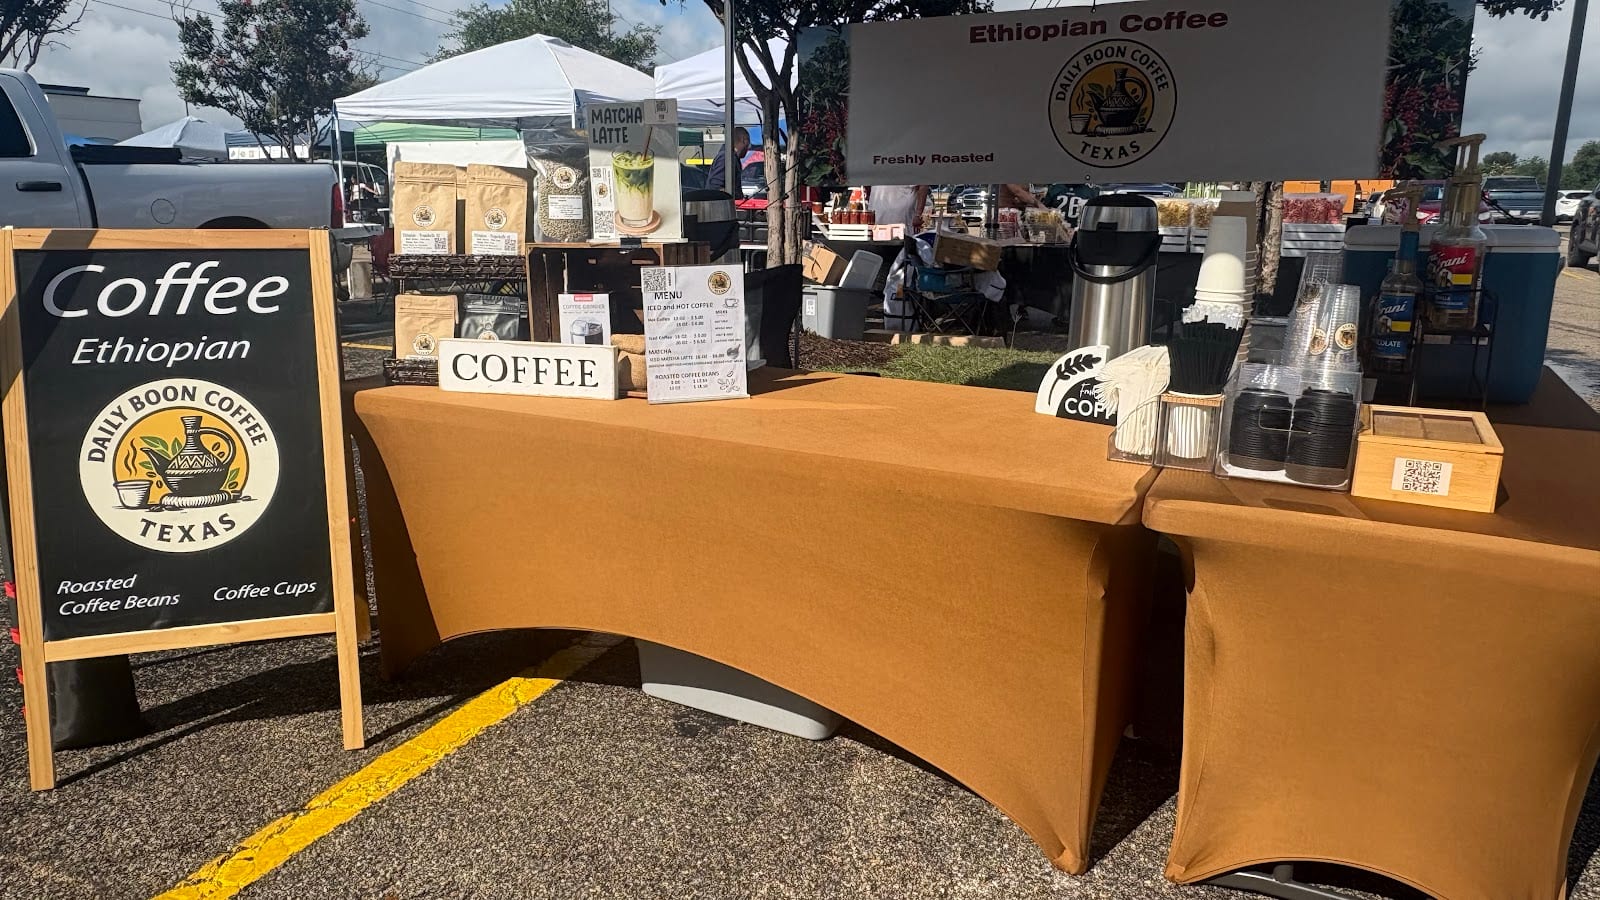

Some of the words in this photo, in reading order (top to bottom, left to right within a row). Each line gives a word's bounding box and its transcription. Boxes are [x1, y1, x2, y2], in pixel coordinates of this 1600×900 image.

[970, 19, 1107, 43] Ethiopian
[1119, 10, 1229, 33] Coffee
[1055, 61, 1082, 101] DAILY
[1083, 45, 1128, 66] BOON
[1130, 49, 1169, 92] COFFEE
[591, 106, 643, 125] MATCHA
[592, 126, 629, 144] LATTE
[873, 153, 926, 166] Freshly
[931, 151, 994, 164] Roasted
[1080, 140, 1140, 160] TEXAS
[43, 261, 290, 318] Coffee
[654, 291, 683, 300] MENU
[71, 335, 251, 368] Ethiopian
[452, 353, 599, 388] COFFEE
[87, 404, 129, 463] DAILY
[128, 385, 198, 413] BOON
[204, 389, 269, 447] COFFEE
[139, 513, 236, 544] TEXAS
[57, 574, 137, 595] Roasted
[213, 584, 270, 602] Coffee
[273, 580, 317, 598] Cups
[59, 595, 126, 616] Coffee
[127, 593, 181, 609] Beans
